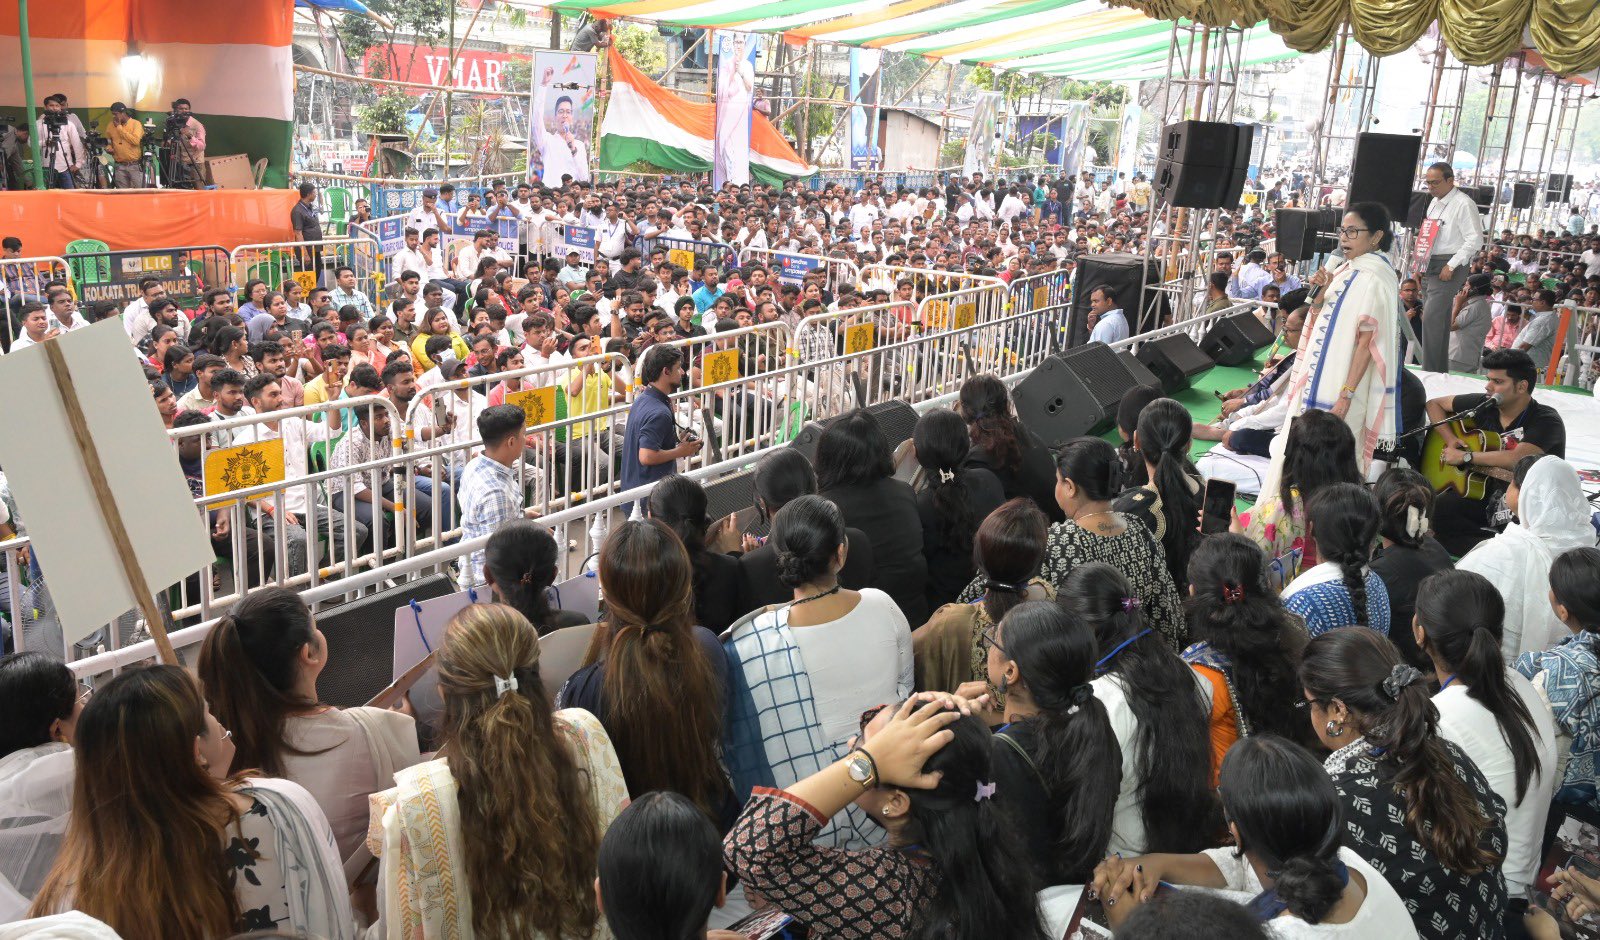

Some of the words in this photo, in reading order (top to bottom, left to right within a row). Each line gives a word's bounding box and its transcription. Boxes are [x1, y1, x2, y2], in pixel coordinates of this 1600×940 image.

[424, 55, 512, 91] VMAR
[146, 256, 169, 269] LIC
[85, 285, 124, 301] KOLKATA
